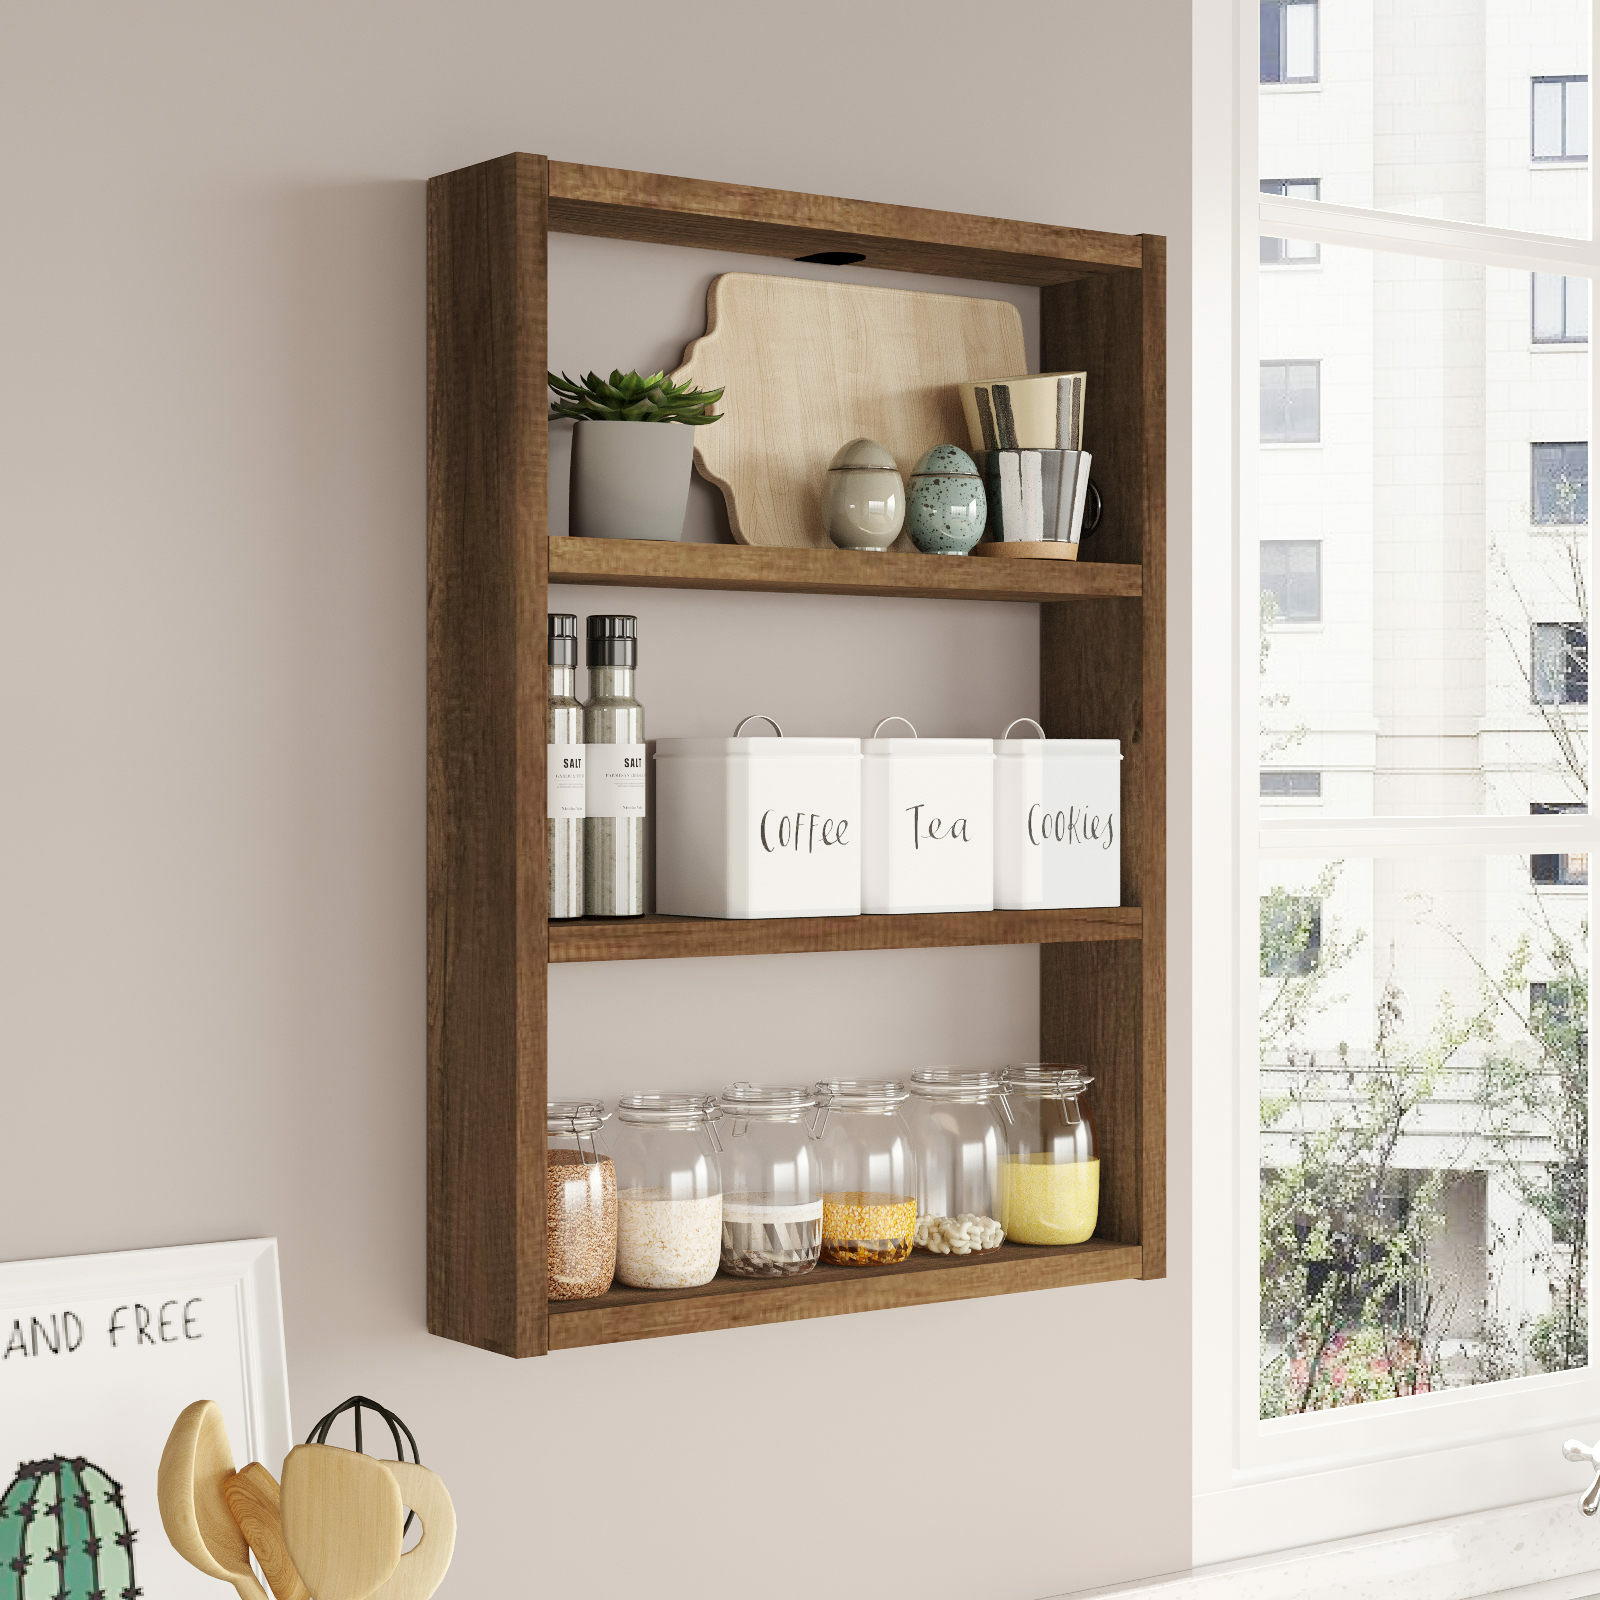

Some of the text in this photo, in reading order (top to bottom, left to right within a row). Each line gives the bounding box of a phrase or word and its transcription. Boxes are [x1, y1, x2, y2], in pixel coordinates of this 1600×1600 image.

[563, 758, 582, 769] SALT
[624, 757, 642, 768] SALT
[905, 804, 971, 850] Tea
[2, 1296, 203, 1360] AND FREE
